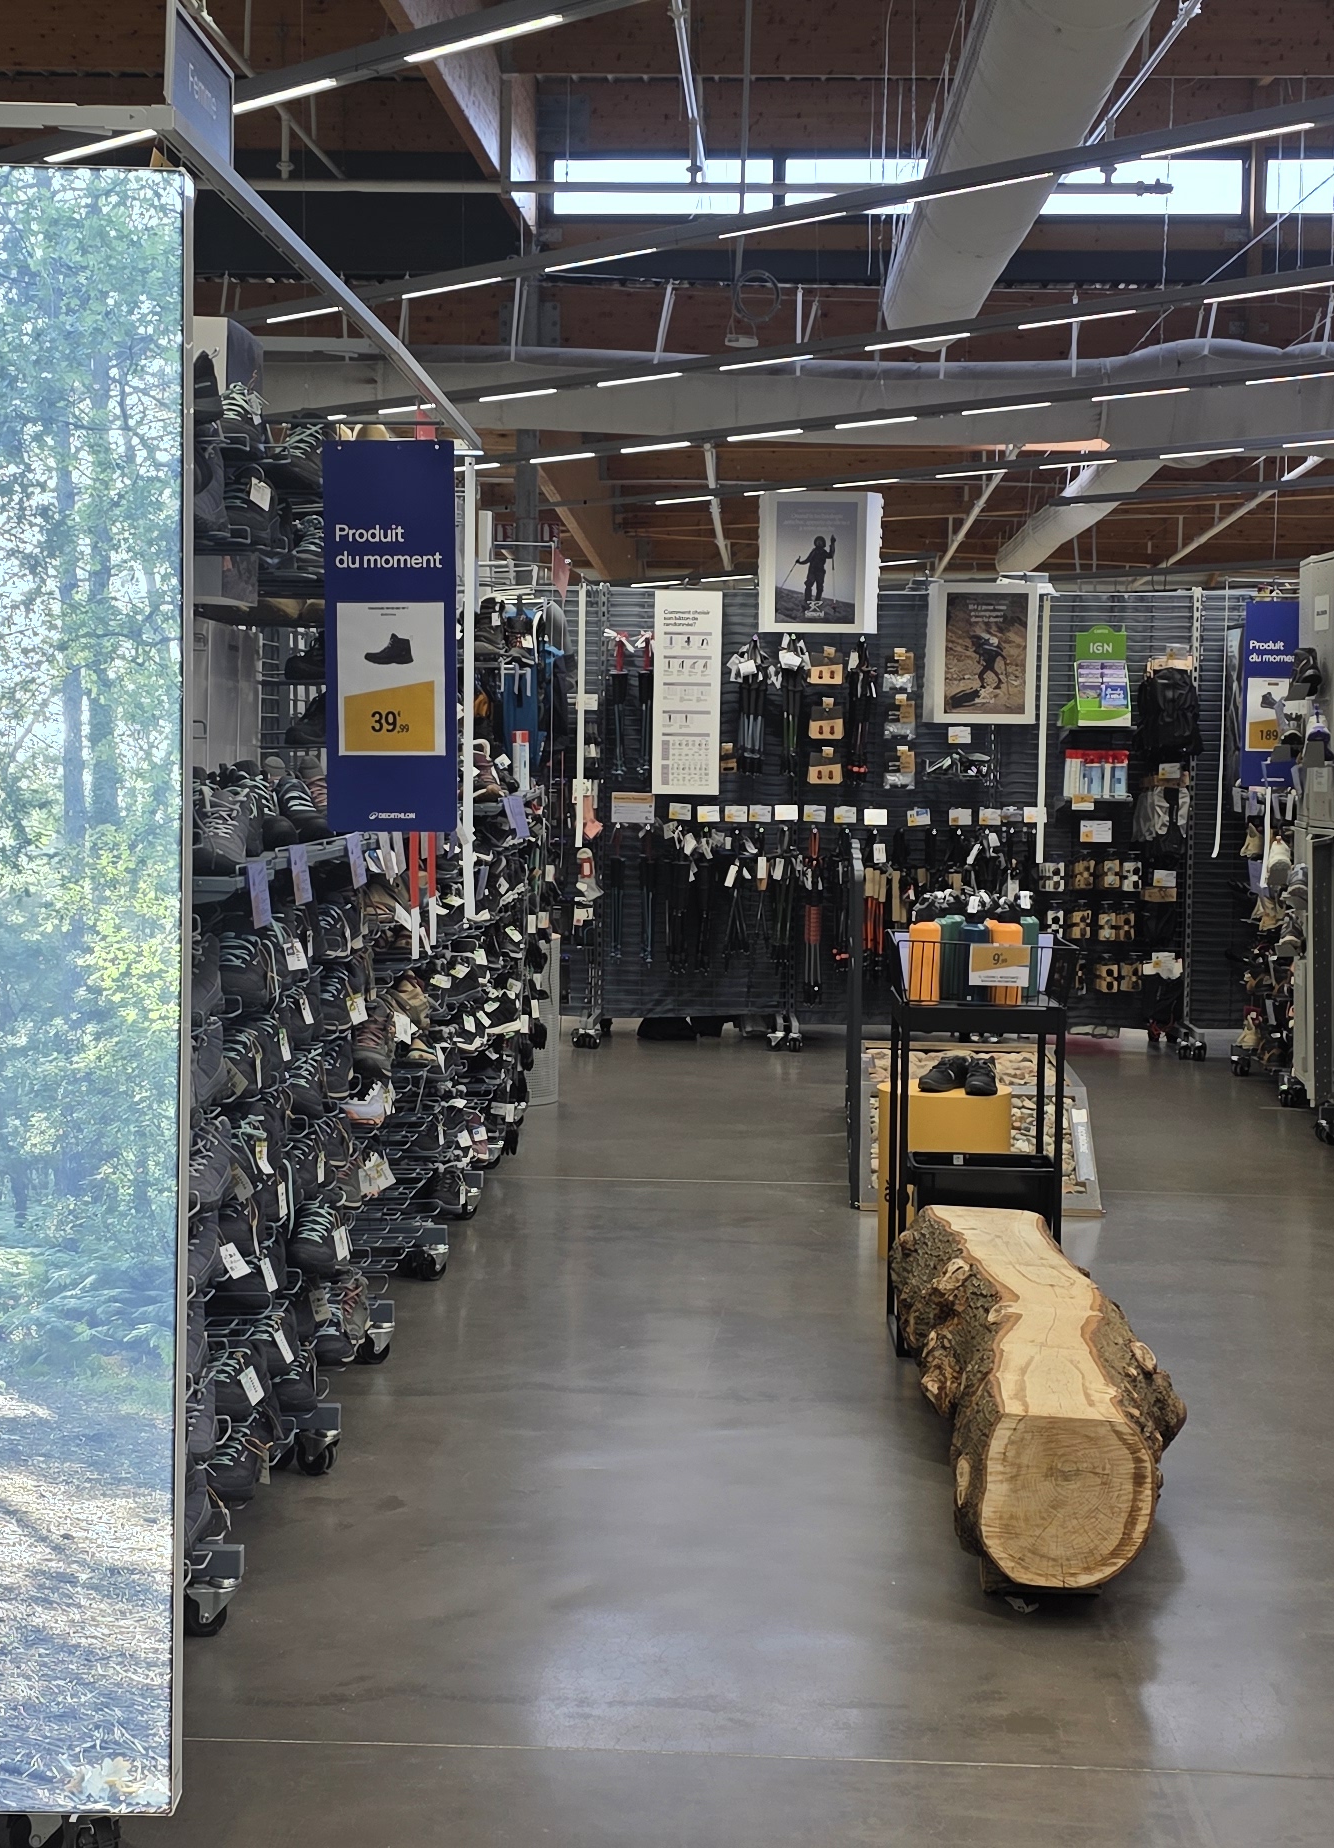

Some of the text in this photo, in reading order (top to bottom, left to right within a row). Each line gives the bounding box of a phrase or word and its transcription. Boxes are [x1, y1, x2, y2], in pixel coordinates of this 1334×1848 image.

[335, 524, 405, 543] Produit
[335, 551, 443, 569] du moment
[1090, 642, 1113, 654] IGN
[1249, 640, 1285, 651] Produit
[1249, 653, 1262, 662] du
